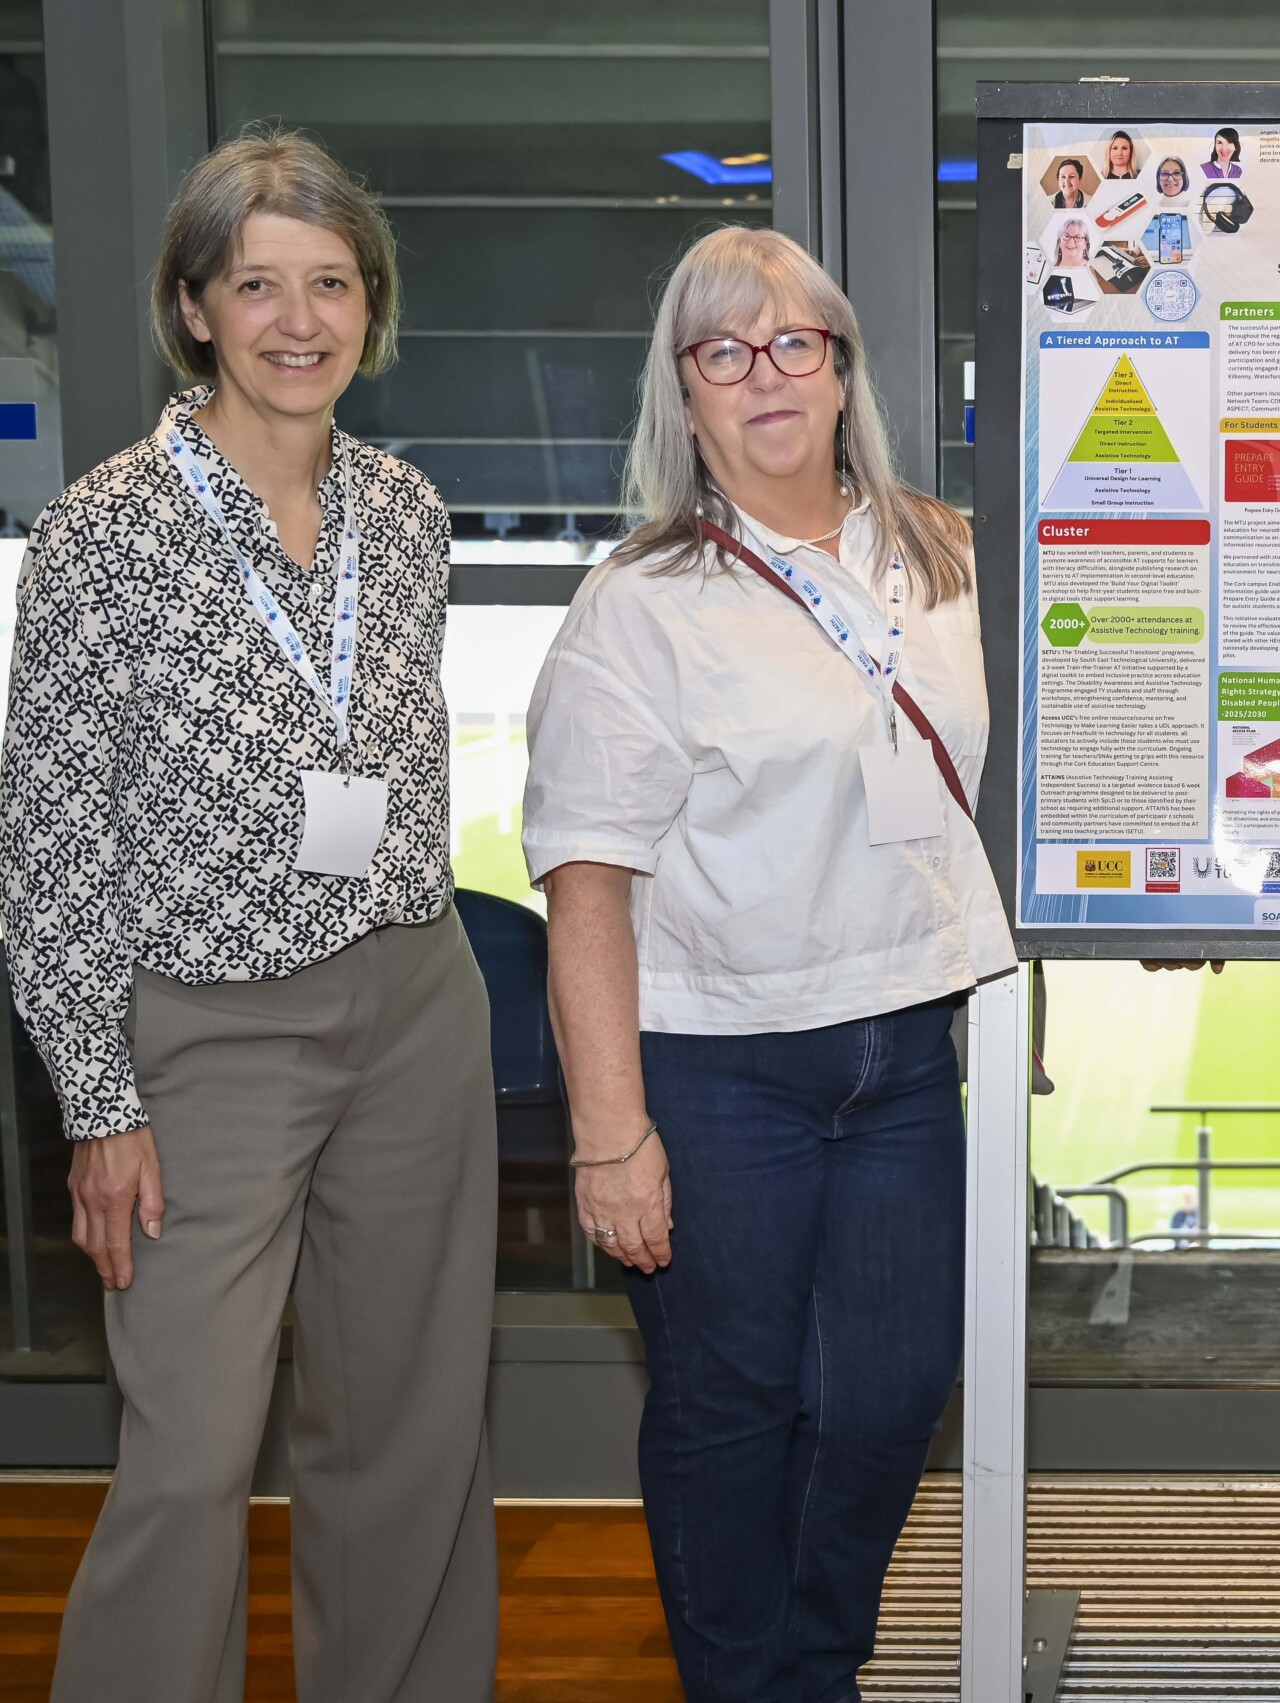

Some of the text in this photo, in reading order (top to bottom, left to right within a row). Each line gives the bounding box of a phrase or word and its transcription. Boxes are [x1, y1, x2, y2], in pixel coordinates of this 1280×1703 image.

[1225, 307, 1274, 316] Partners
[1046, 336, 1053, 345] A
[1057, 336, 1091, 345] Tiered
[1095, 336, 1147, 346] Approach
[1165, 336, 1180, 345] AT
[1235, 453, 1275, 462] PREPARE
[1235, 464, 1264, 472] ENTRY
[188, 467, 201, 484] PATH
[1235, 474, 1264, 483] GUIDE
[1043, 526, 1089, 536] Cluster
[770, 560, 784, 575] PATH
[830, 619, 841, 632] PATH
[1050, 619, 1085, 629] 2000+
[1126, 627, 1168, 635] Technology
[284, 636, 297, 653] PATH
[1222, 688, 1246, 697] Rights
[1098, 861, 1122, 871] UCC
